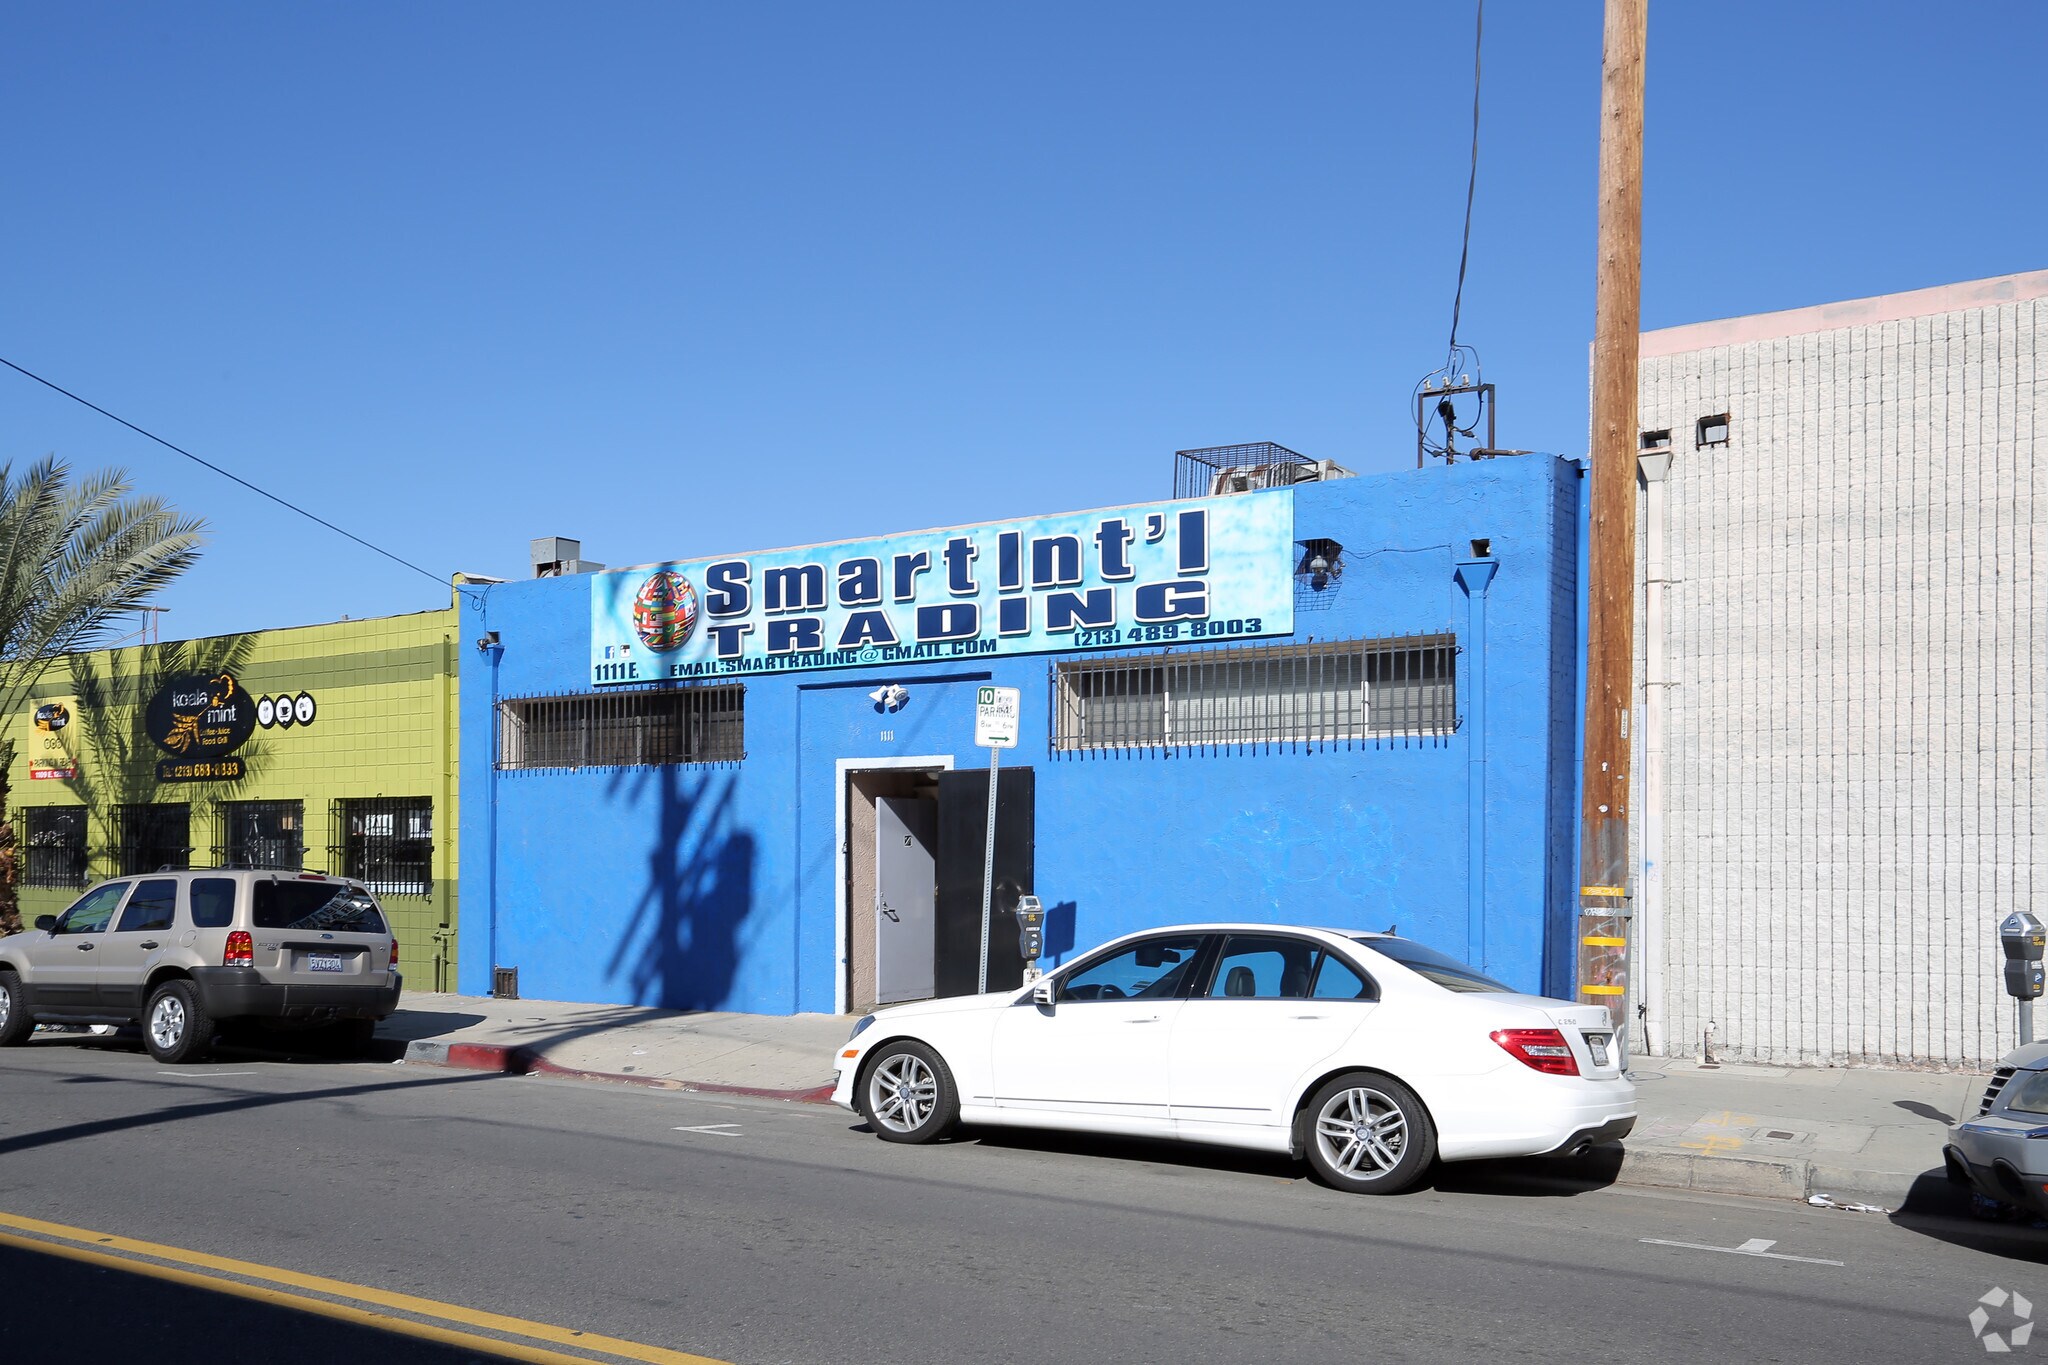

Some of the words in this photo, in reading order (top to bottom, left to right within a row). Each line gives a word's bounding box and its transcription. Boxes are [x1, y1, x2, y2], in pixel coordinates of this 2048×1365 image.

[704, 536, 980, 618] Smart
[705, 578, 1212, 659] TRADING
[1074, 629, 1121, 647] (213)
[1127, 617, 1262, 642] 489-8003
[594, 662, 626, 681] 1111
[172, 689, 208, 708] koala
[980, 690, 993, 704] 10
[207, 704, 237, 723] mint
[880, 730, 894, 742] 1111
